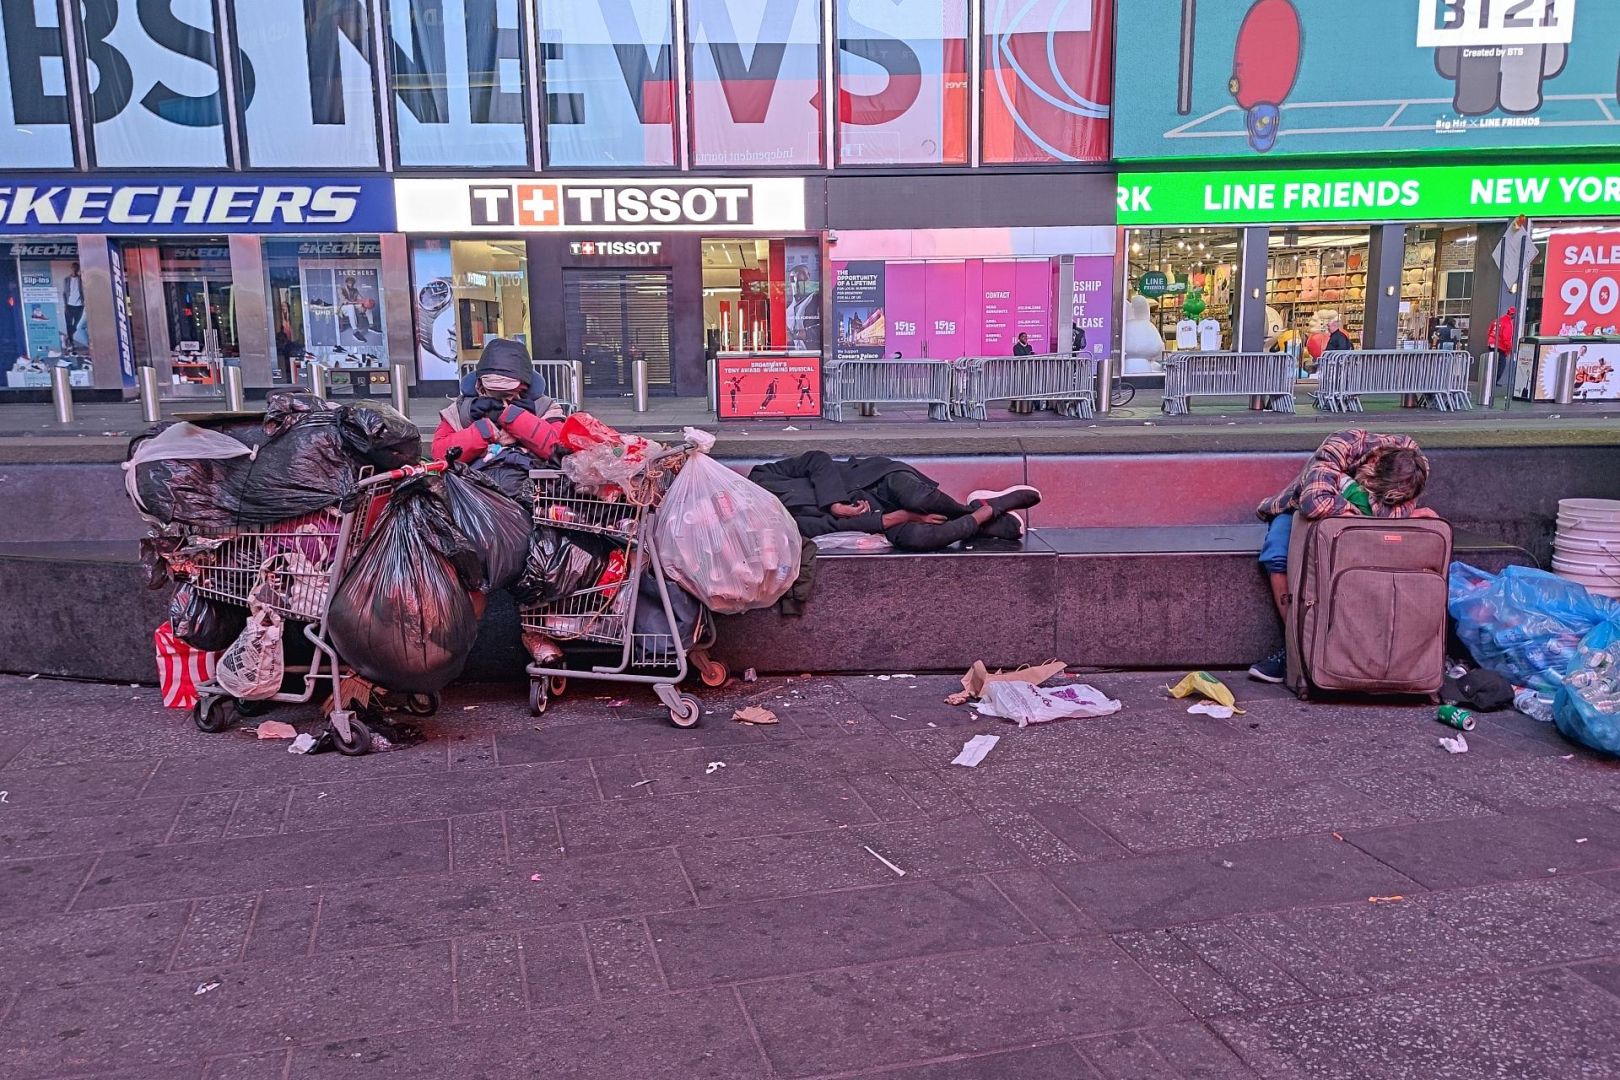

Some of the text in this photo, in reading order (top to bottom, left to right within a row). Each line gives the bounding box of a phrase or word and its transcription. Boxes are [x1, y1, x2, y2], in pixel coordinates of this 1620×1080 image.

[1434, 0, 1559, 30] BT21
[1463, 47, 1524, 58] Created by BTS
[303, 0, 922, 126] NEWS
[1436, 114, 1452, 129] Big
[1453, 113, 1467, 127] Hit
[1480, 118, 1500, 127] LINE
[1502, 117, 1540, 127] FRIENDS
[1205, 184, 1279, 211] LINE
[1284, 179, 1420, 209] FRIENDS
[1470, 177, 1550, 205] NEW
[567, 187, 749, 223] TISSOT
[594, 241, 662, 255] TISSOT
[1563, 245, 1620, 265] SALE
[1145, 277, 1164, 285] LINE
[985, 291, 1011, 299] CONTACT
[1560, 276, 1620, 316] 90
[110, 249, 133, 377] SKECHERS
[894, 321, 916, 332] 1515
[934, 320, 956, 331] 1515
[1076, 317, 1104, 328] LEASE
